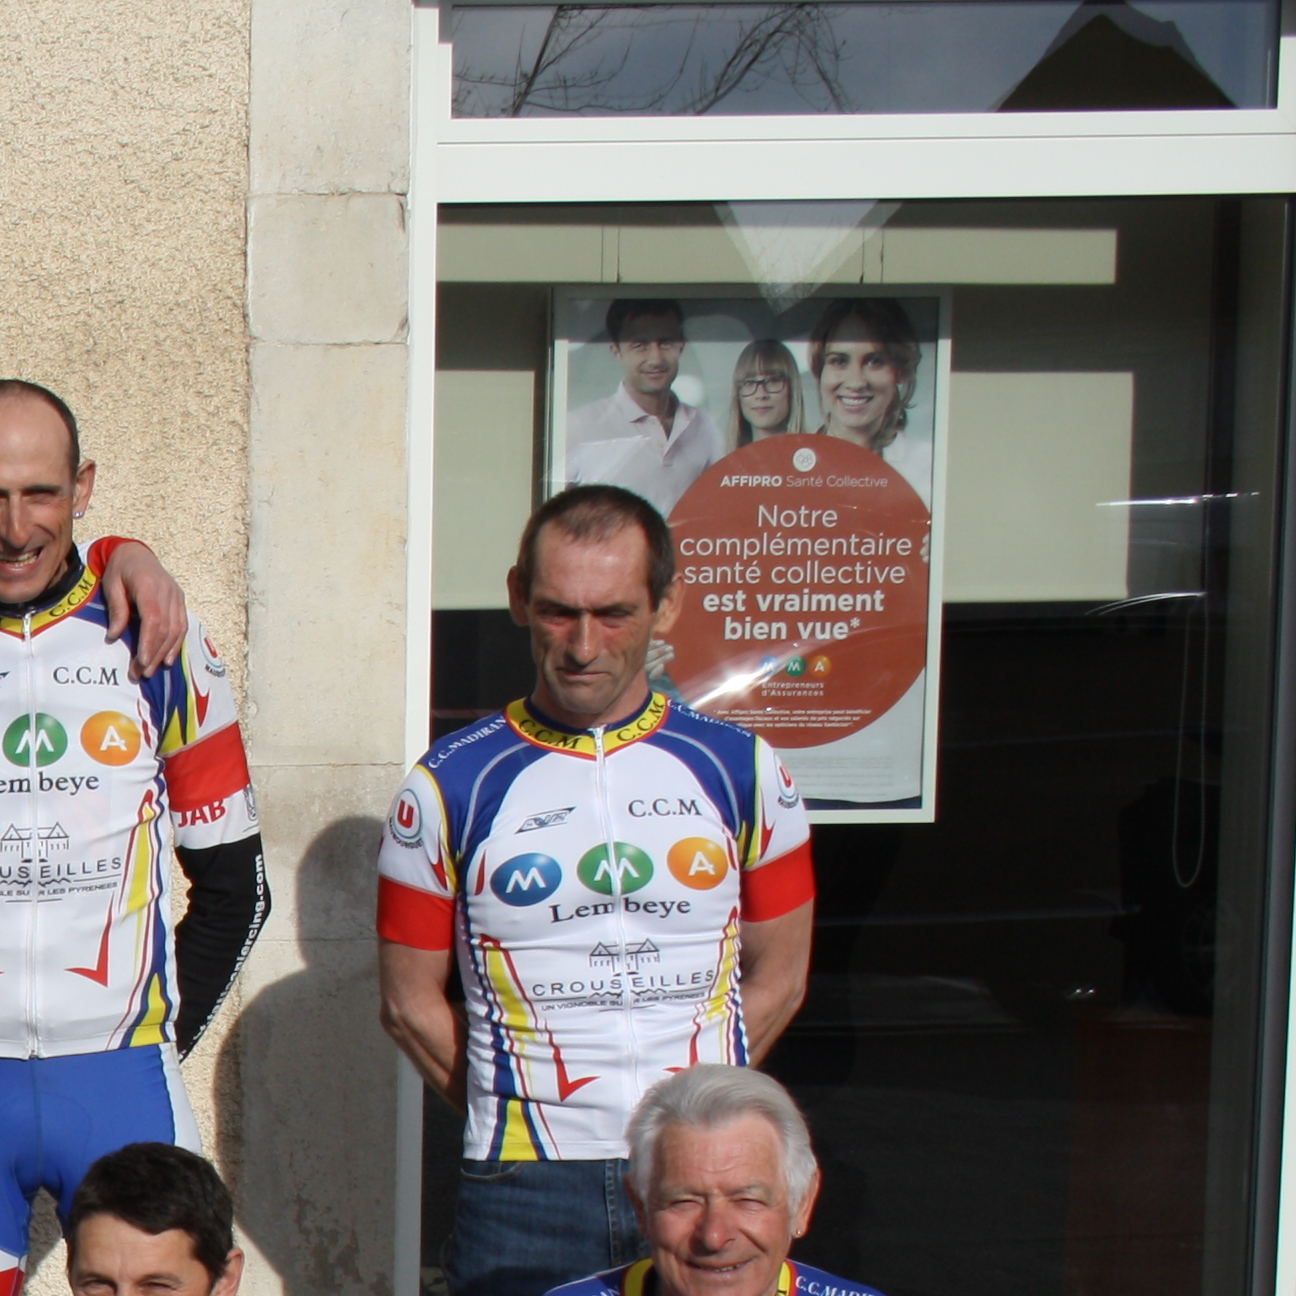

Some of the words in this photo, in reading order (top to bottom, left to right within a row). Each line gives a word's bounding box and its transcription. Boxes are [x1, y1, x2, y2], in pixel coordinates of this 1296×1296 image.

[720, 475, 783, 488] AFFIPRO
[786, 476, 823, 488] Santé
[826, 475, 888, 488] Collective
[758, 505, 838, 528] Notre
[679, 532, 913, 560] complémentaire
[683, 562, 761, 584] santé
[770, 562, 906, 584] collective
[48, 577, 95, 619] C.C.M
[703, 590, 746, 612] est
[756, 589, 885, 612] vraiment
[724, 617, 787, 640] bien
[53, 665, 120, 687] C.C.M
[517, 717, 583, 751] C.C.M
[616, 699, 666, 743] C.C.M
[428, 716, 507, 771] C.C.MADIRAN
[178, 797, 227, 828] JAB
[397, 800, 414, 825] U
[627, 798, 703, 818] C.C.M
[548, 897, 692, 925] Lembeye
[531, 969, 715, 997] CROUSEILLES
